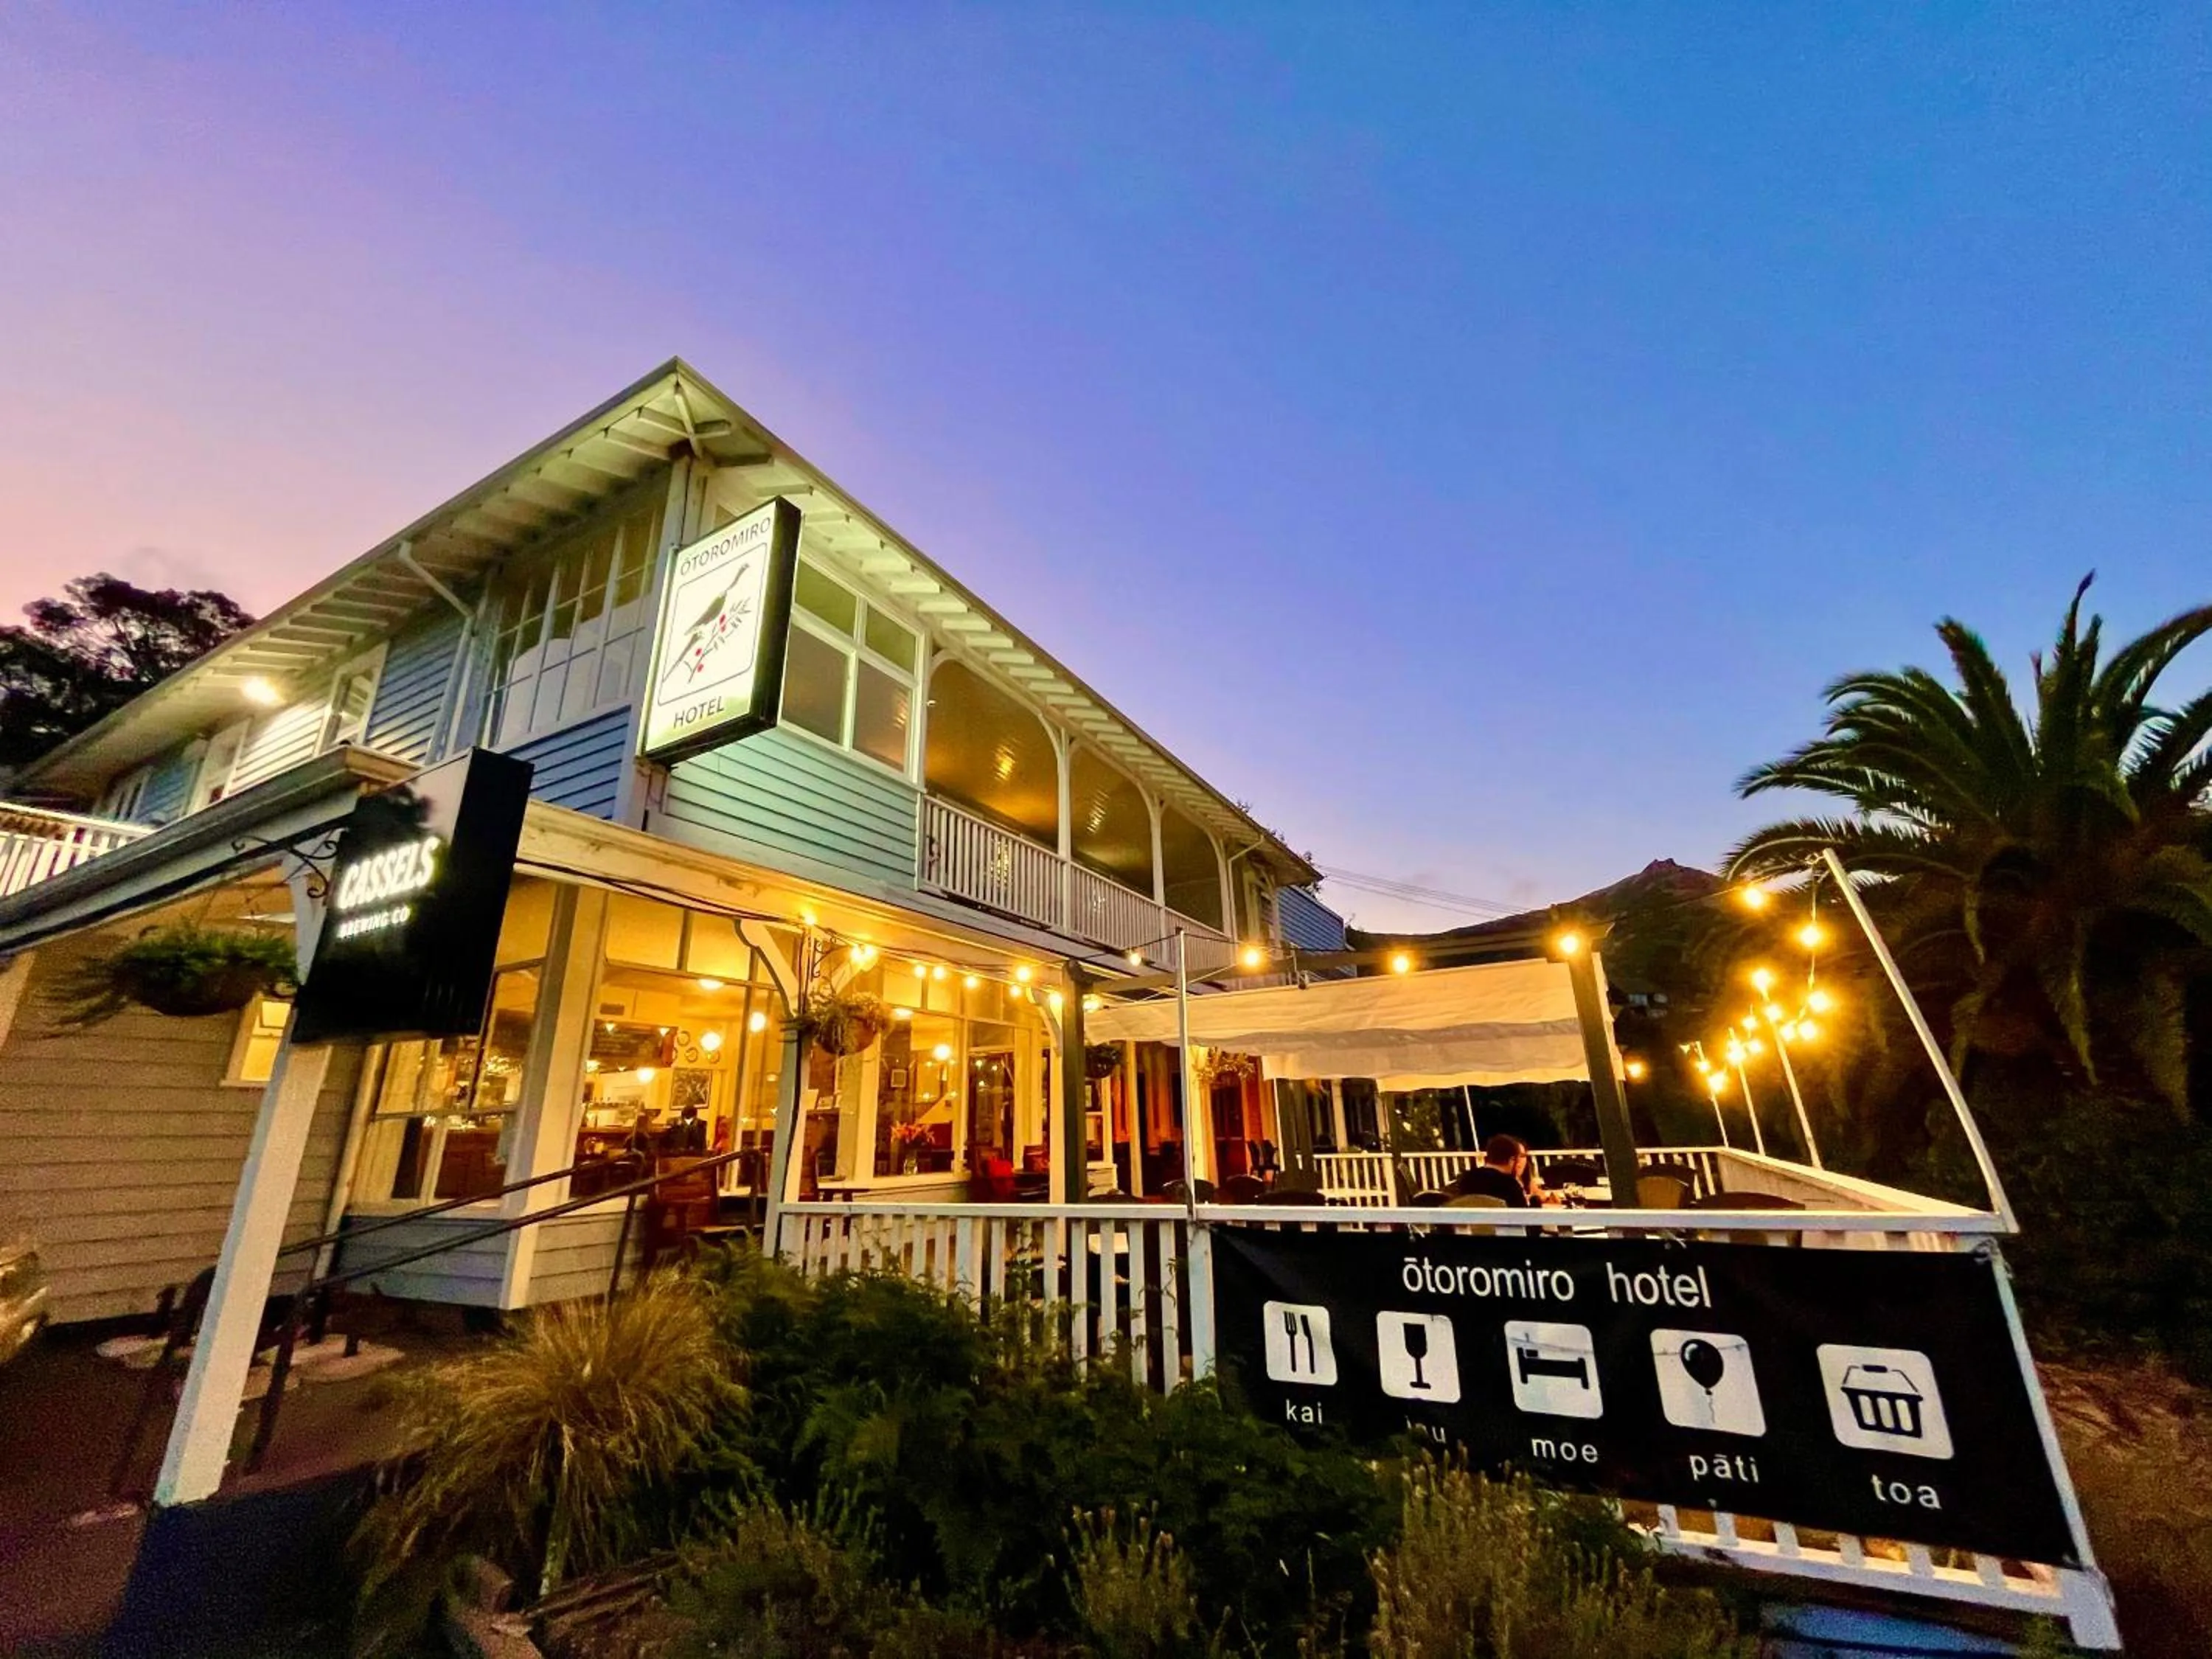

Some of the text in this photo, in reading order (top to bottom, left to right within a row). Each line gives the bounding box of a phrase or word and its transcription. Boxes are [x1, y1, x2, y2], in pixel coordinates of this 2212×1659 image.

[672, 695, 725, 728] HOTEL
[336, 835, 441, 909] CASSELS
[335, 905, 411, 939] BREWING CO
[1402, 1256, 1711, 1308] ōtoromiro hotel
[1286, 1399, 1322, 1425] kai
[1531, 1439, 1599, 1463] moe
[1689, 1454, 1759, 1483] pāti
[1871, 1474, 1941, 1509] toa
